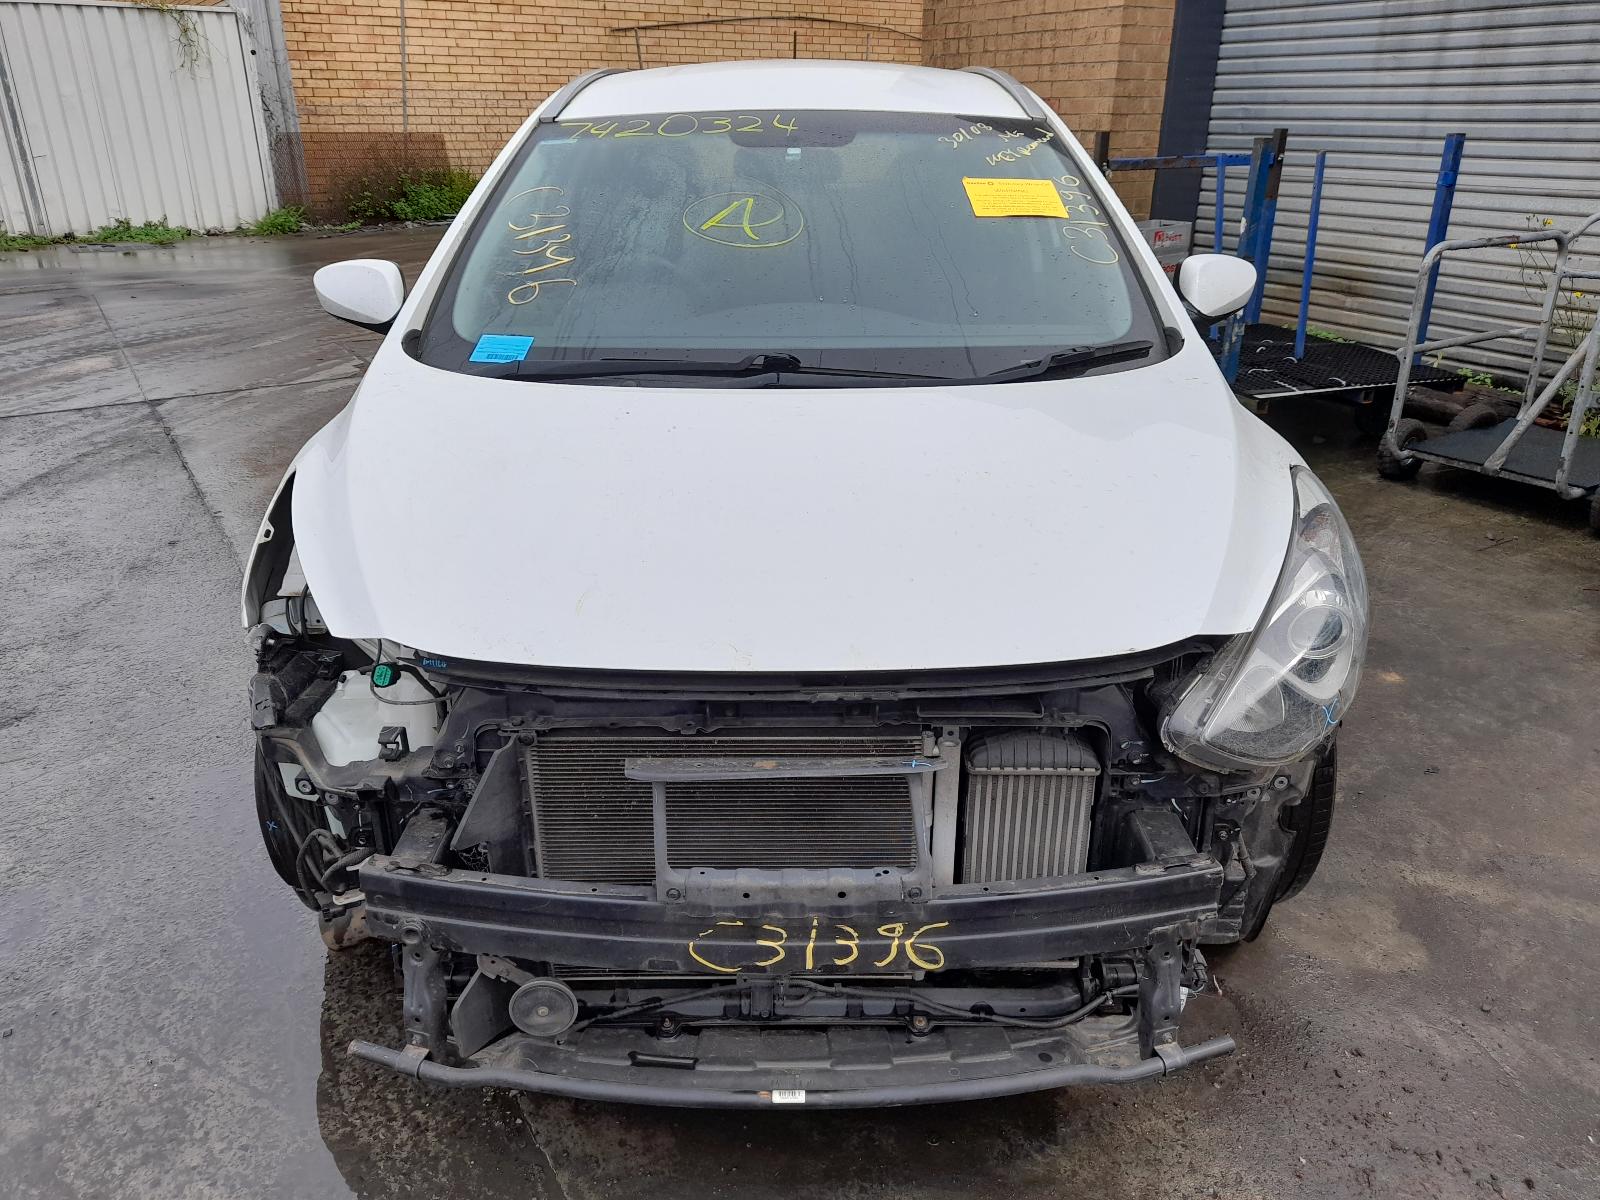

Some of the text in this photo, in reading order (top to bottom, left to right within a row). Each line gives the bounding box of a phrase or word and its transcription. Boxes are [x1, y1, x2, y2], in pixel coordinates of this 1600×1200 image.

[559, 113, 799, 141] 7420324
[699, 196, 761, 241] A
[1053, 174, 1119, 265] C31396
[688, 916, 950, 973] C31396
